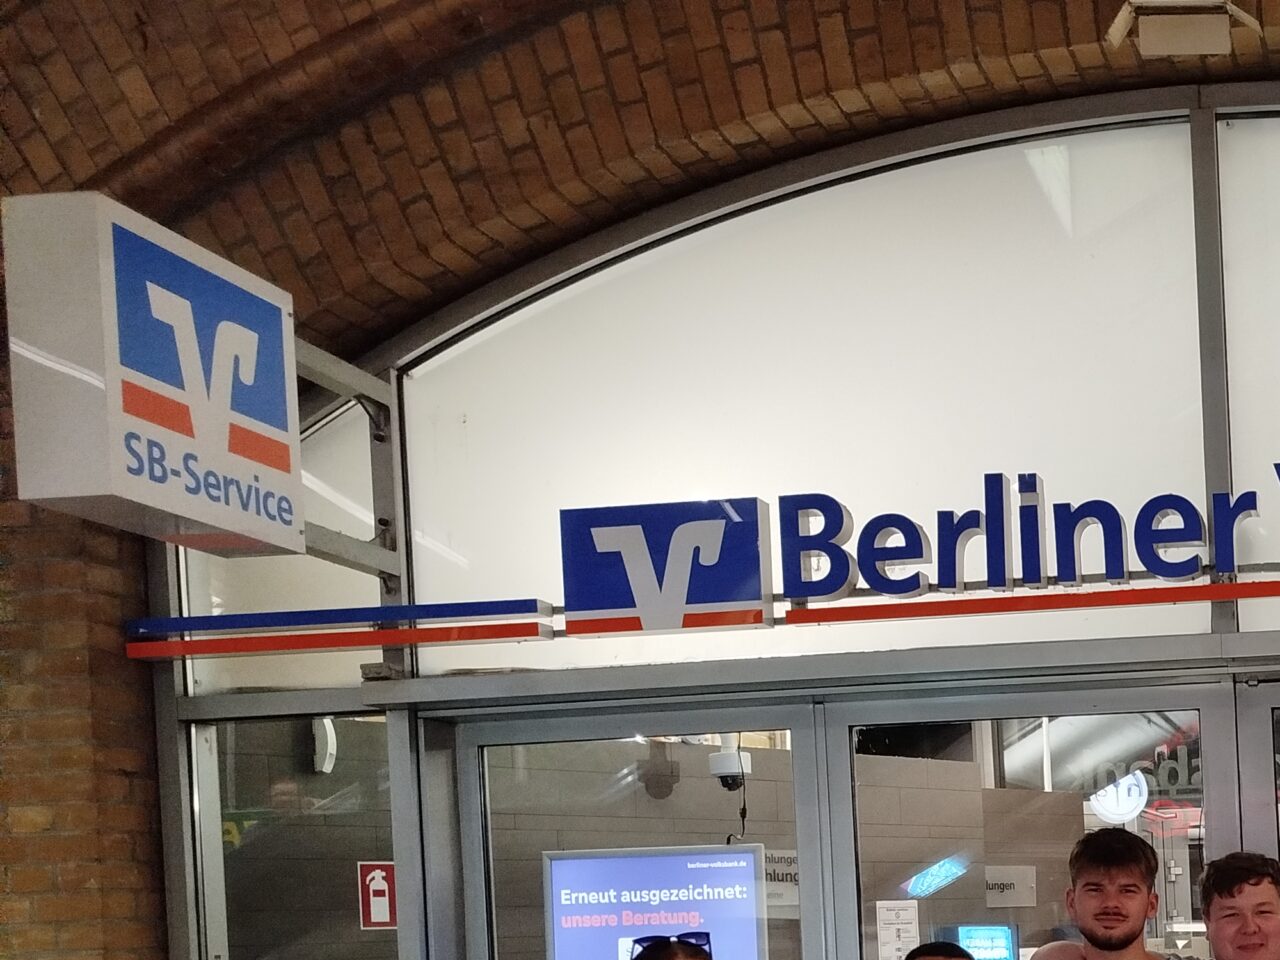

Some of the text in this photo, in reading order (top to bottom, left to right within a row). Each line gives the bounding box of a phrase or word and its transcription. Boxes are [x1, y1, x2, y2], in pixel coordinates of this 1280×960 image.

[124, 431, 295, 527] SB-Service
[778, 472, 1257, 599] Berliner
[560, 884, 748, 905] Erneut ausgezeichnet:
[561, 910, 705, 929] unsere Beratung.
